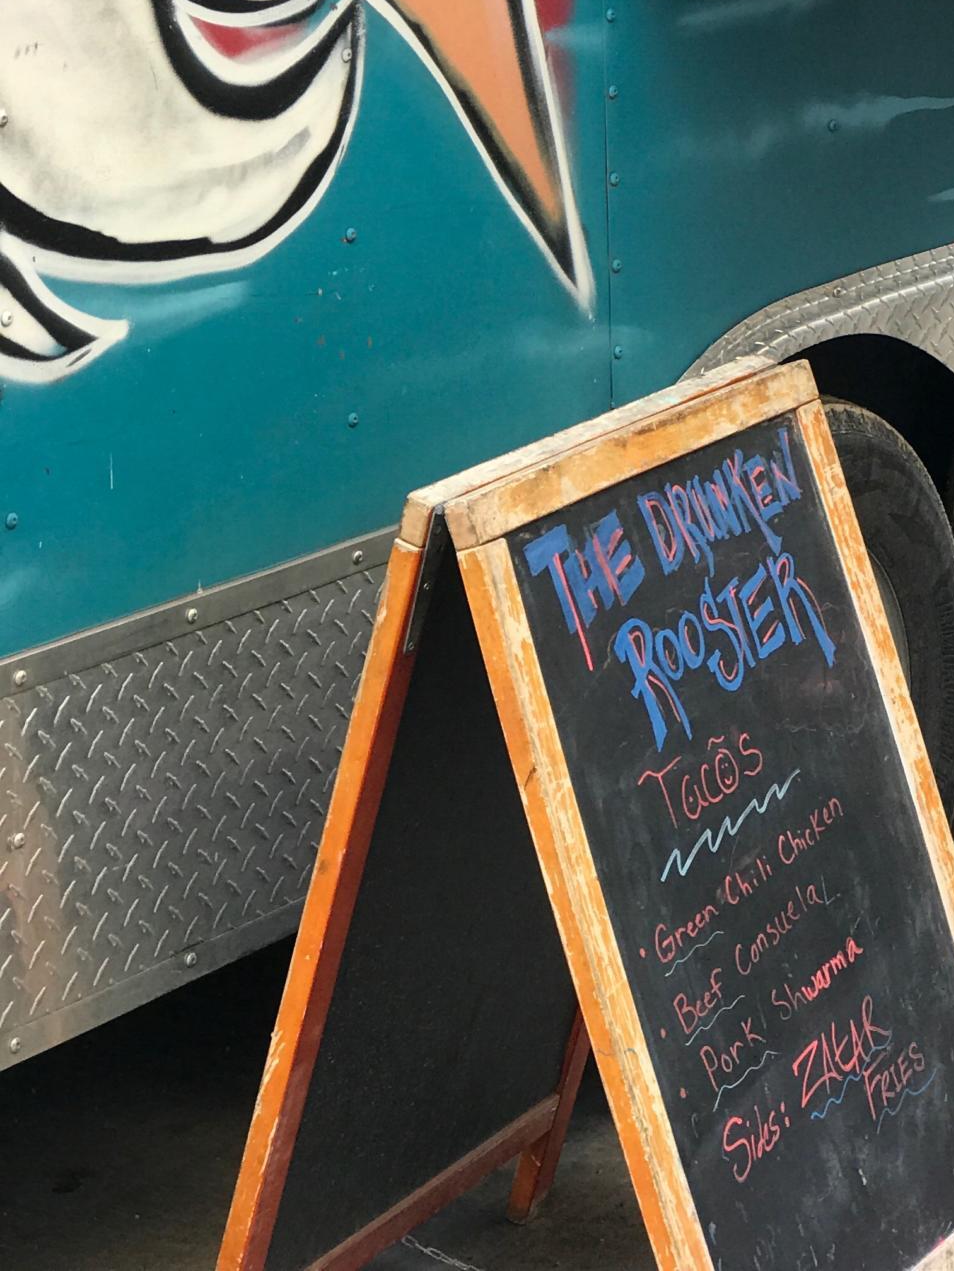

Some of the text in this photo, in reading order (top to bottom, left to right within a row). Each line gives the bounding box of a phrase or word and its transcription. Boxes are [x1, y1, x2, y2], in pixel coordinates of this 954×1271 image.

[523, 427, 802, 672] THE DRUNKEN
[614, 552, 837, 753] ROOSTER
[655, 797, 844, 964] Green Chili Chicken
[673, 969, 723, 1034] Beef
[701, 1017, 767, 1092] Pork
[863, 1041, 926, 1121] FRIES
